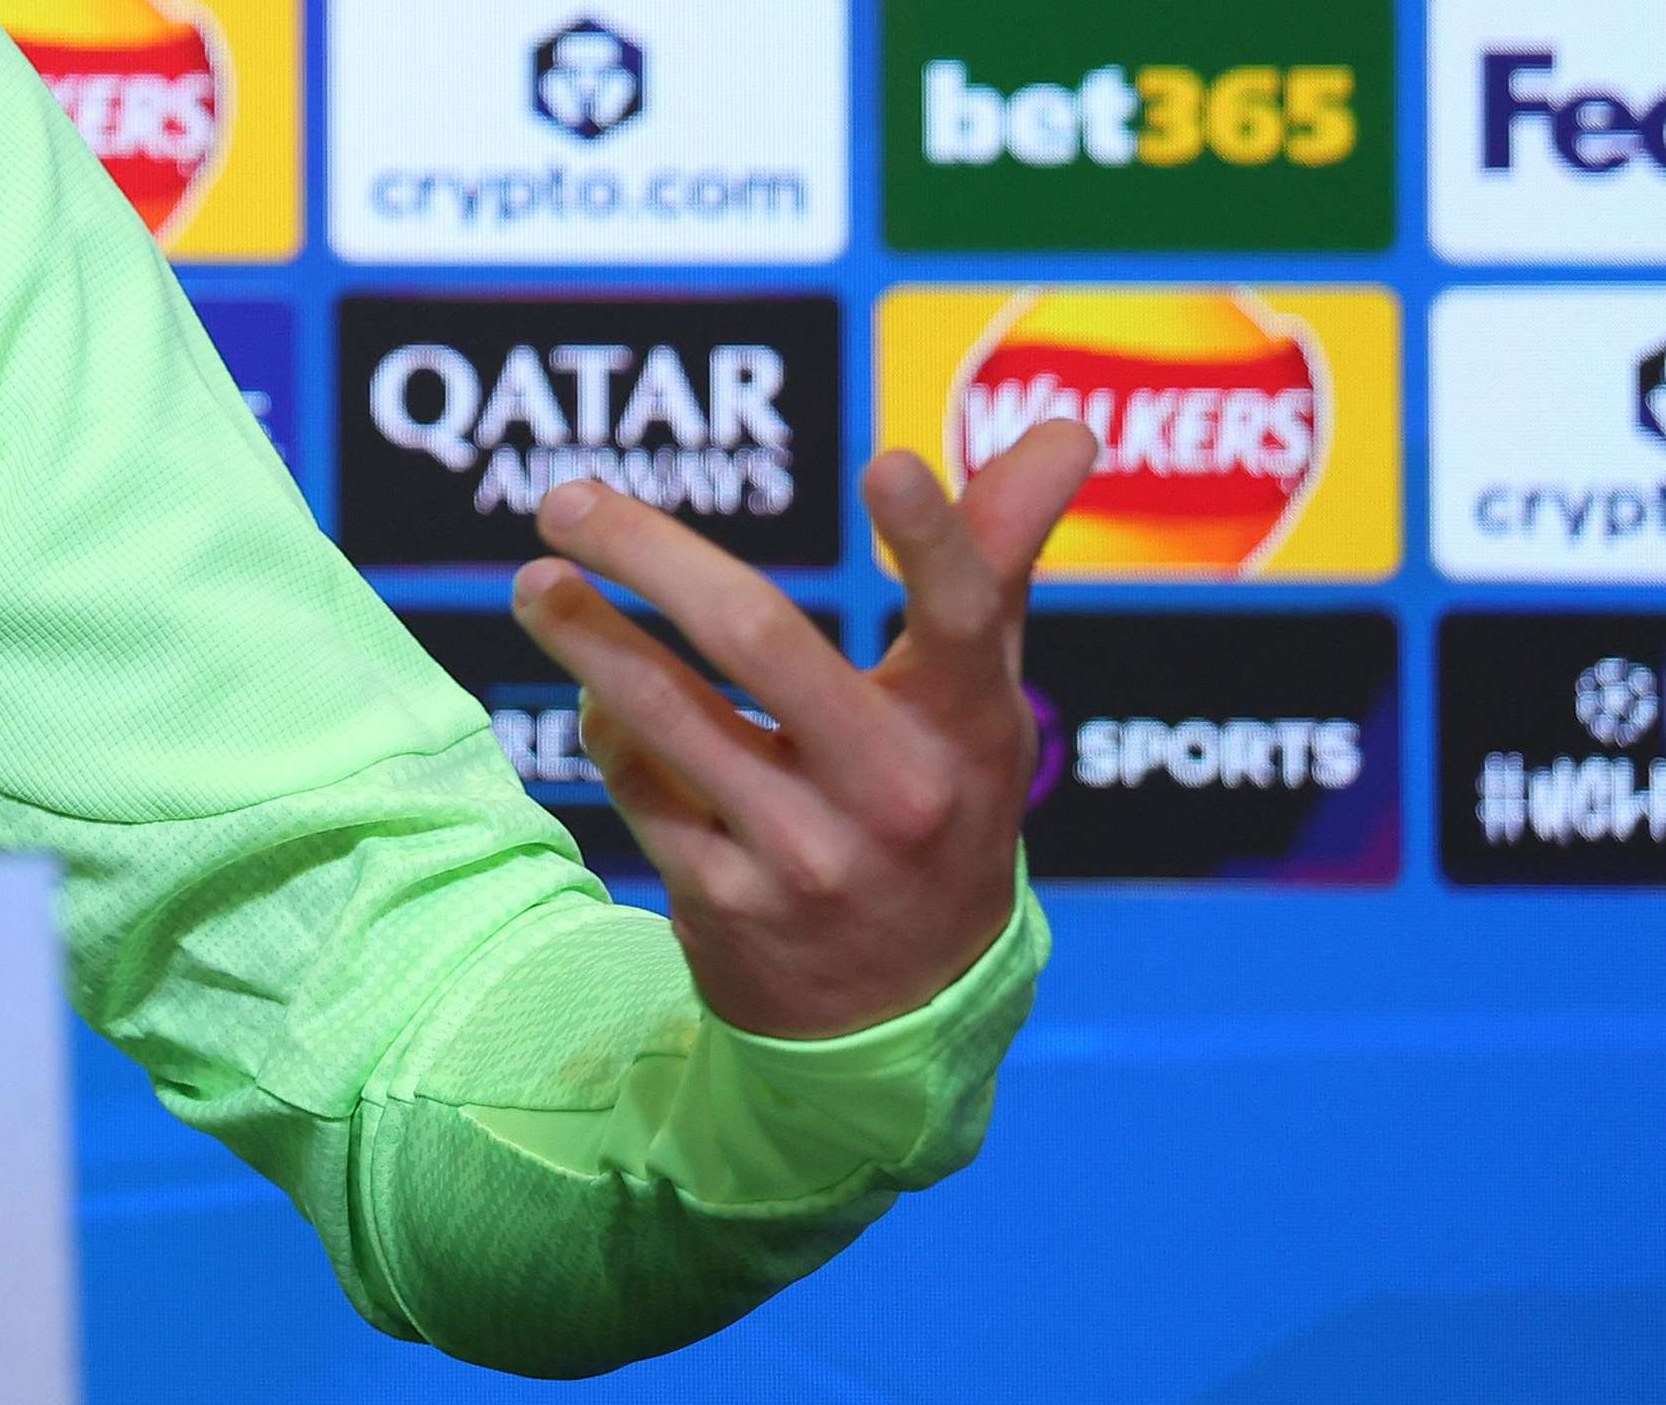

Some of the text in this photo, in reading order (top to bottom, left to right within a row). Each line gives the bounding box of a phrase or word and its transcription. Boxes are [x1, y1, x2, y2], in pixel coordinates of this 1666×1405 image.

[922, 58, 1356, 168] bet365
[1482, 52, 1666, 172] Fe
[371, 162, 810, 224] crypto.com
[368, 343, 791, 473] QATAR
[1074, 716, 1363, 790] SPORTS
